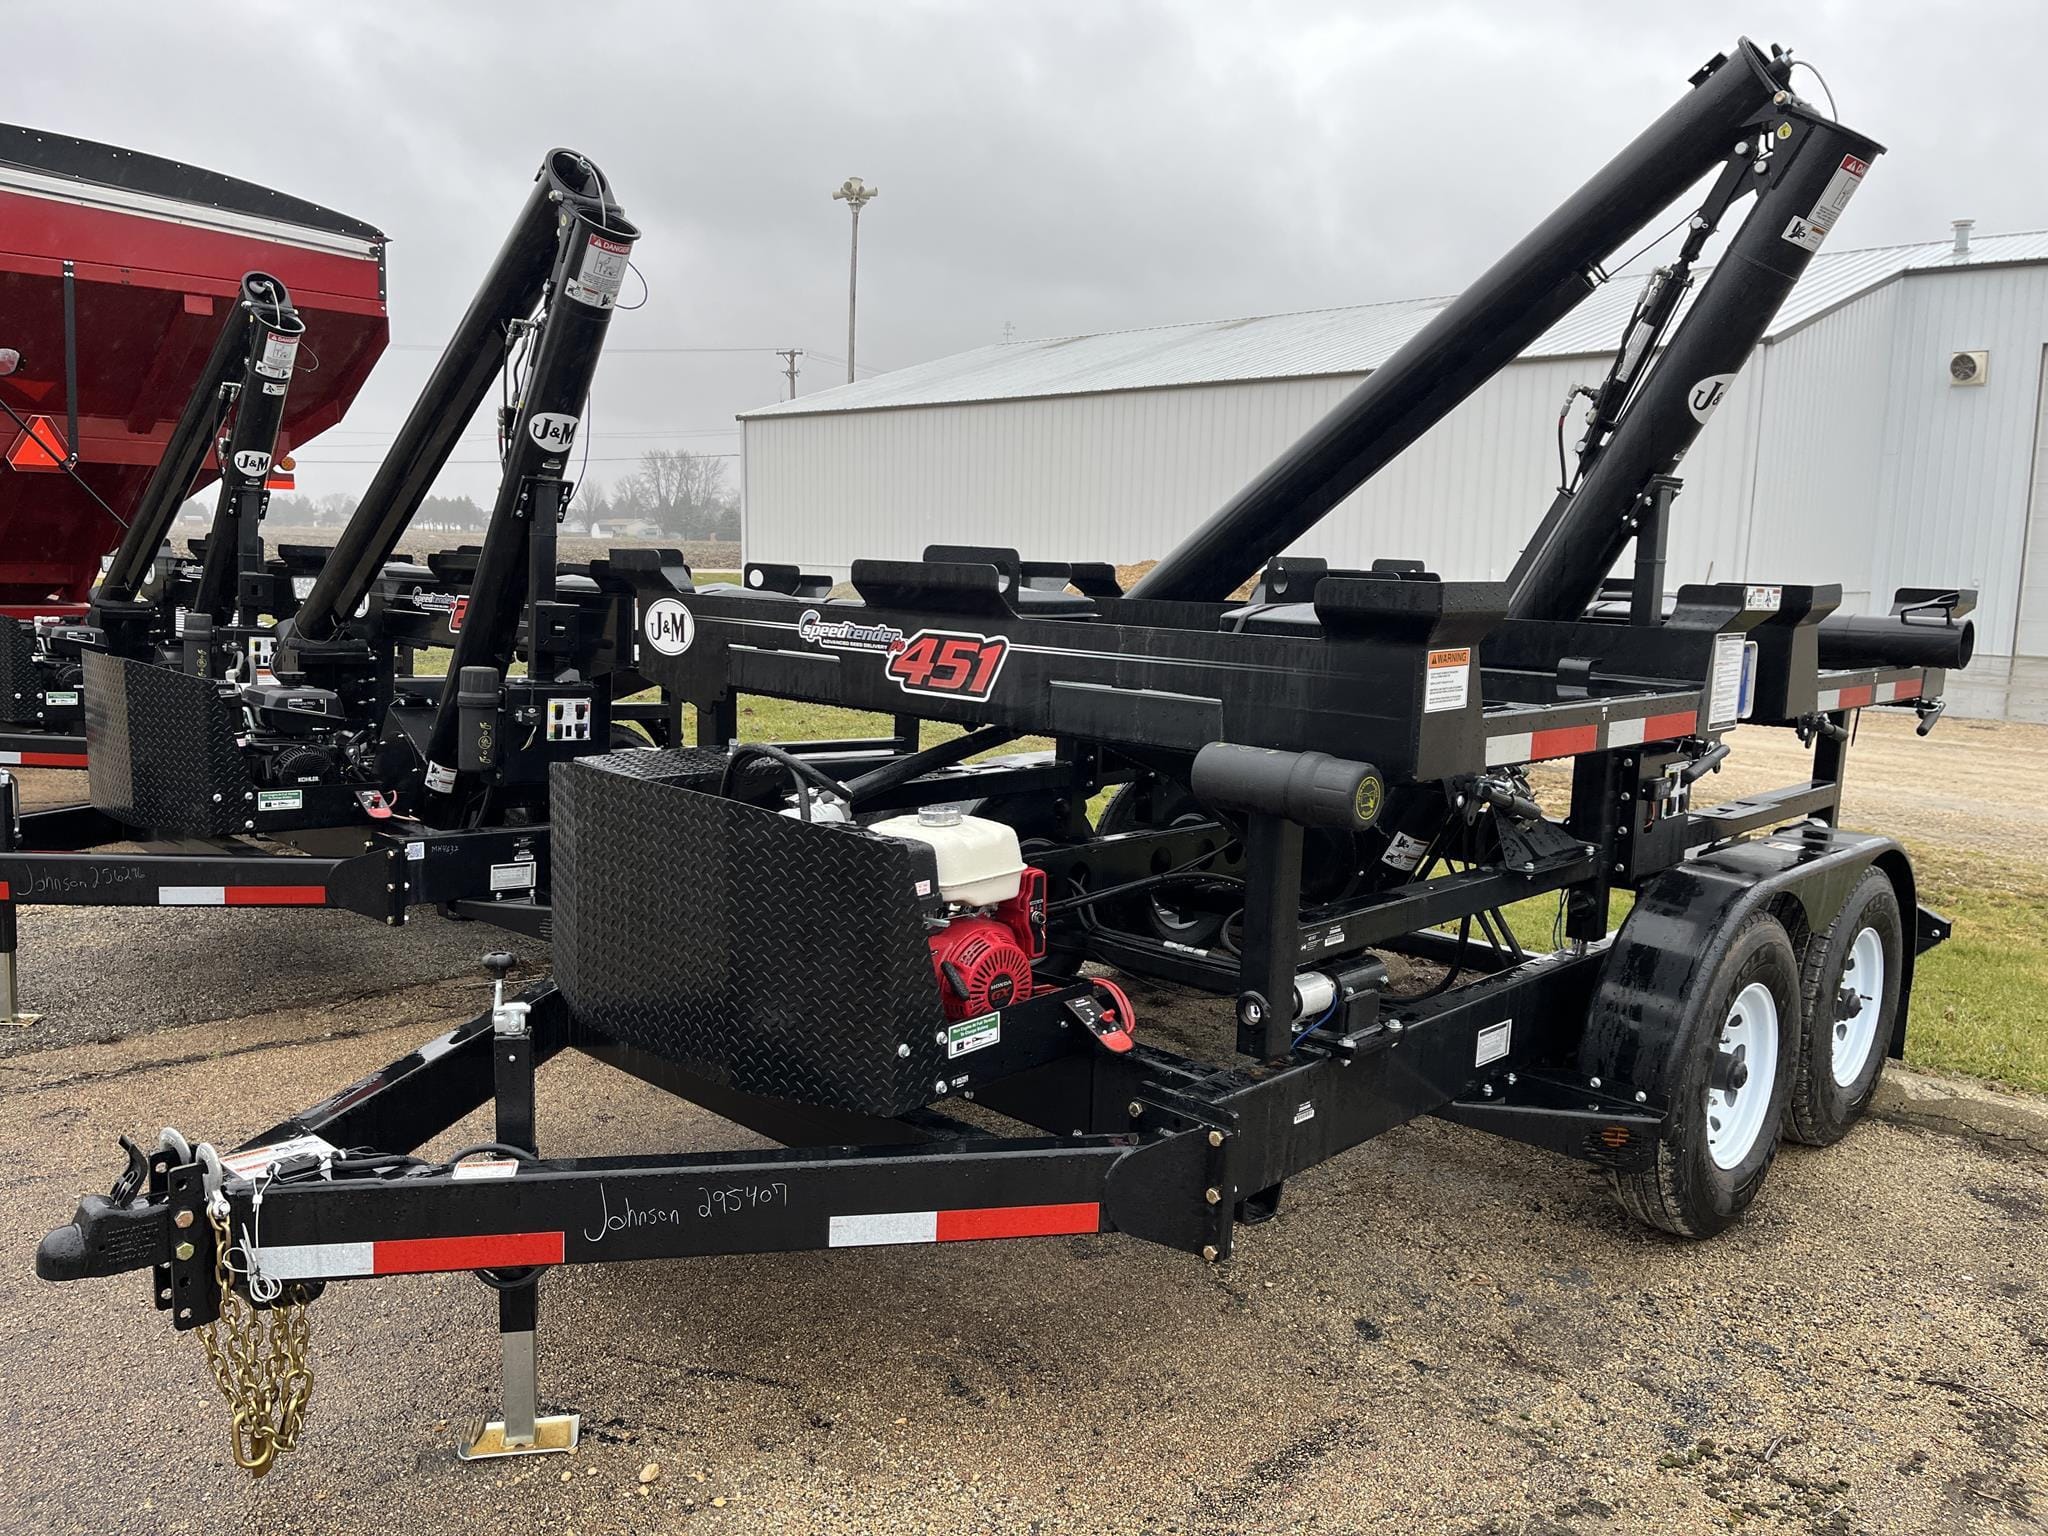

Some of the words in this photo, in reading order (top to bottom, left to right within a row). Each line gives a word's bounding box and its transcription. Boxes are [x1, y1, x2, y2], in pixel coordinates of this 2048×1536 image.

[603, 241, 630, 254] DANGER
[533, 417, 578, 445] J&M
[237, 454, 270, 472] J&M
[650, 611, 686, 643] J&M
[892, 637, 1003, 693] 451
[1437, 652, 1467, 664] WARNING
[16, 863, 88, 896] Johnson
[991, 980, 1012, 989] HONDA
[584, 1182, 680, 1242] Johnson
[698, 1183, 788, 1218] 295407
